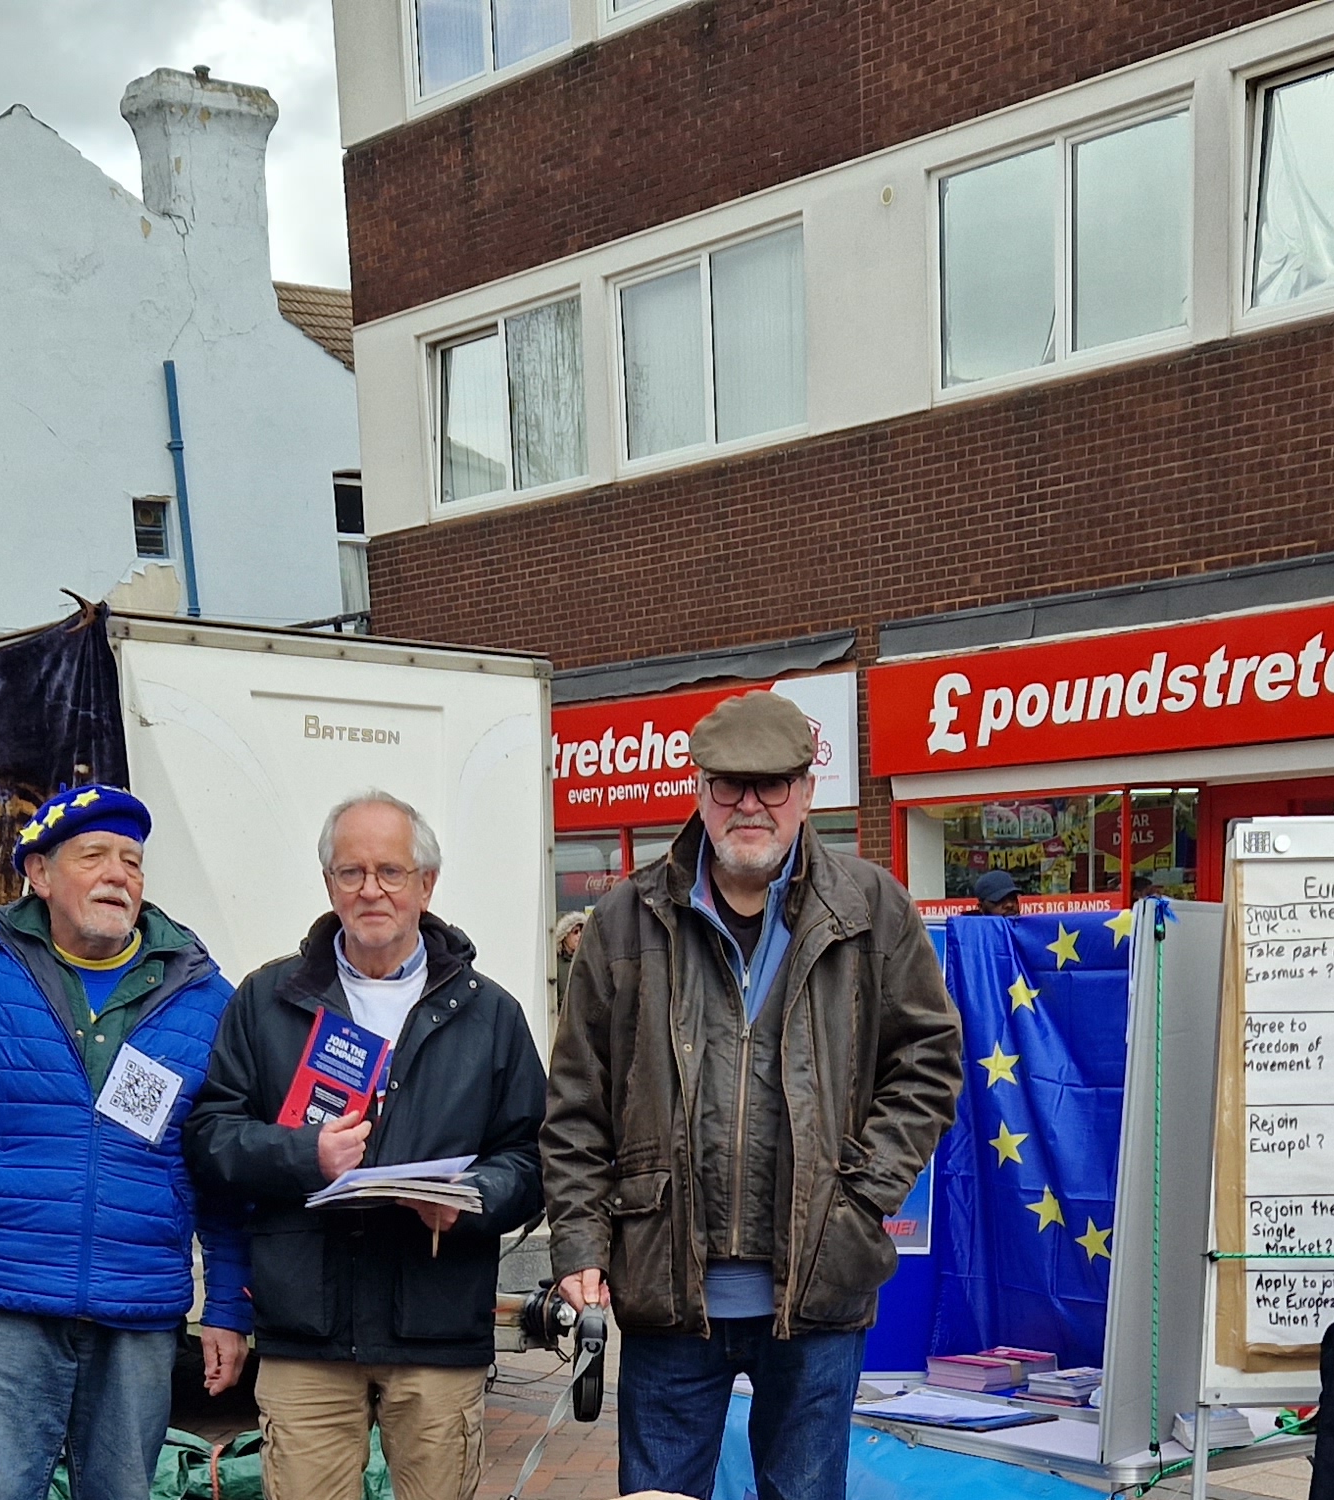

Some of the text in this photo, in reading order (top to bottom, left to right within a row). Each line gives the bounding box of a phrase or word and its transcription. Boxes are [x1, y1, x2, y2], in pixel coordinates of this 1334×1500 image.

[926, 673, 971, 755] £
[551, 721, 697, 780] tretche
[567, 786, 604, 808] every
[607, 781, 651, 804] penny
[1117, 813, 1150, 829] SAR
[1112, 829, 1155, 846] DALS
[1046, 901, 1065, 913] BIG
[1067, 899, 1111, 912] BRANDS
[1245, 904, 1299, 925] Should
[1247, 943, 1285, 959] Take
[1292, 942, 1327, 962] part
[1244, 1016, 1307, 1039] Agree to
[324, 1043, 365, 1069] CAMPAIGN
[327, 1034, 350, 1051] JOIN
[350, 1043, 368, 1060] THE
[1243, 1036, 1323, 1055] Freedom of
[1249, 1113, 1298, 1136] Rejoin
[1249, 1133, 1311, 1159] Europol
[1250, 1200, 1303, 1224] Rejoin
[1255, 1273, 1297, 1292] Apply
[1302, 1275, 1317, 1289] to
[1255, 1294, 1281, 1309] the
[1268, 1311, 1309, 1327] Union
